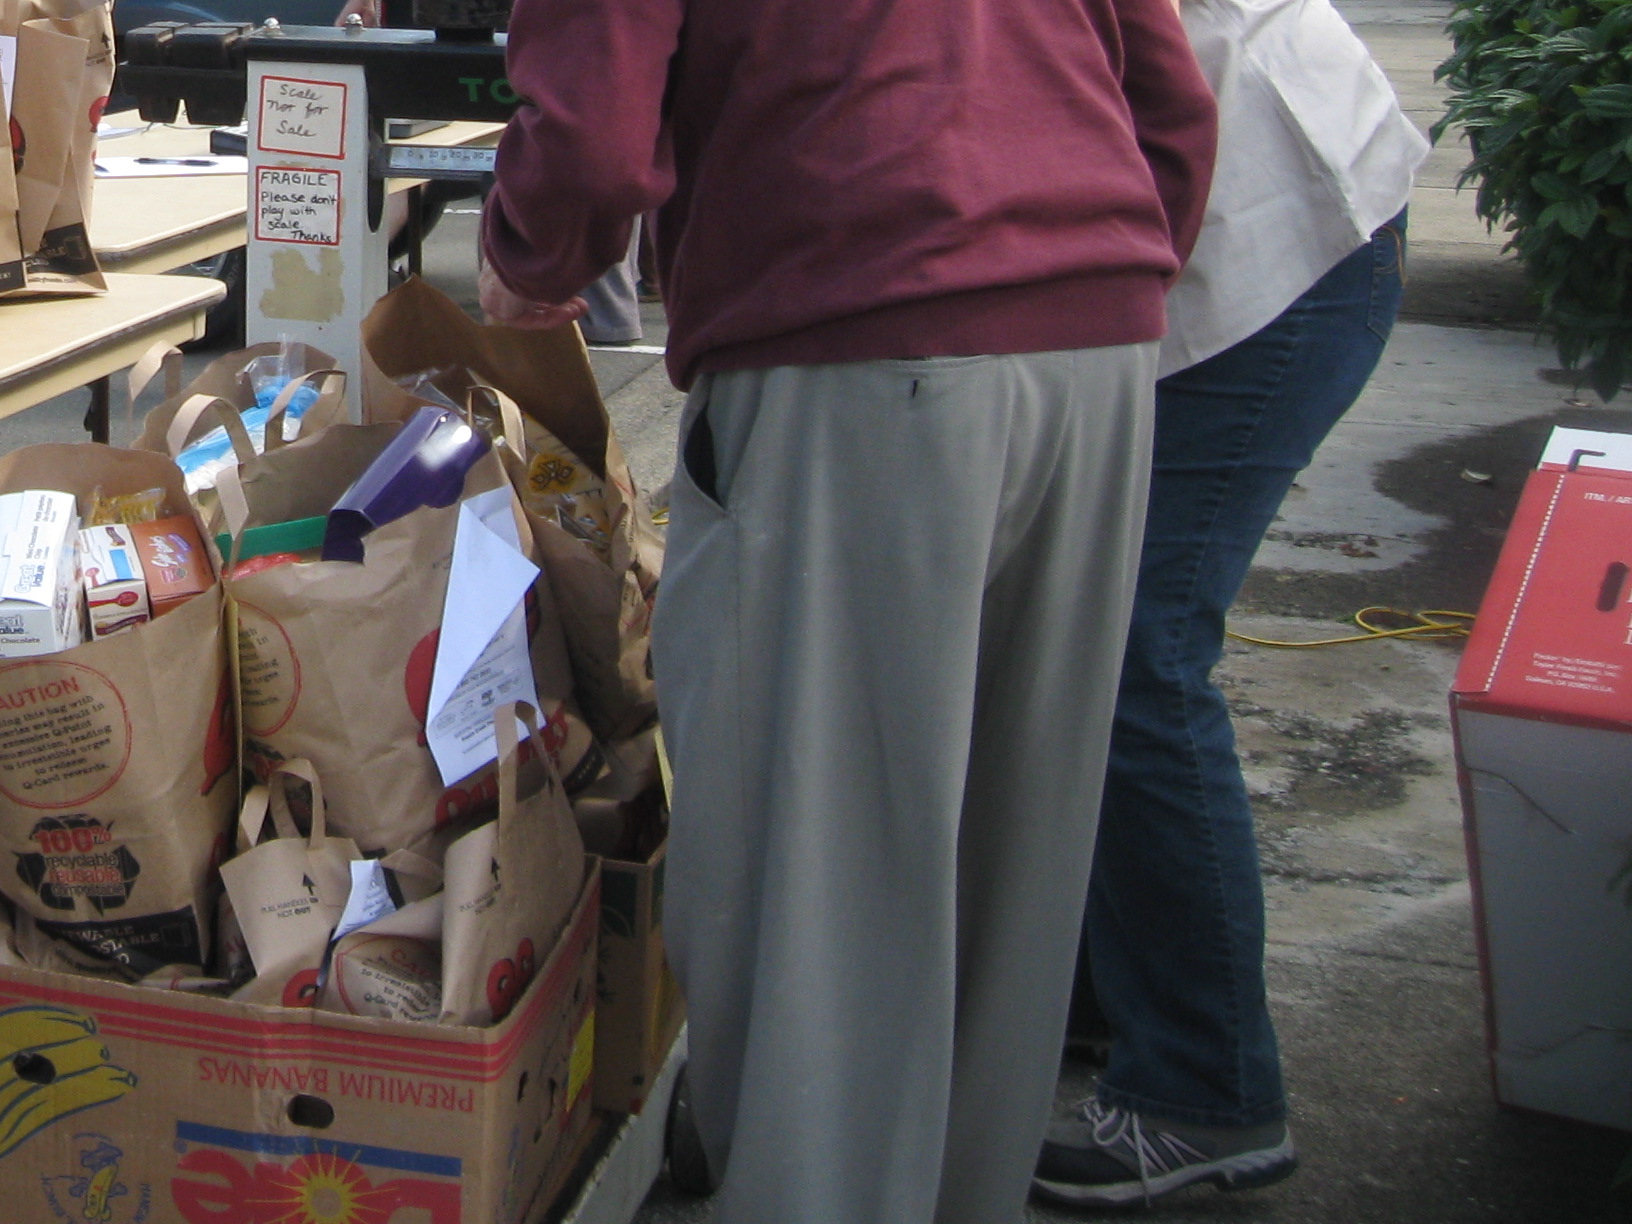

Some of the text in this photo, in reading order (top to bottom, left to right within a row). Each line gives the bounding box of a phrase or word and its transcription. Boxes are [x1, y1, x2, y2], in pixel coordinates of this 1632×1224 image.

[279, 83, 323, 101] Scale
[304, 102, 329, 119] for
[276, 119, 317, 137] Sale
[260, 171, 328, 187] FRAGILE
[261, 191, 337, 206] Please don't
[261, 205, 317, 222] play with
[290, 229, 333, 244] Thanks
[23, 710, 46, 721] this
[46, 704, 68, 716] bag
[68, 695, 94, 708] with
[57, 709, 91, 724] result
[69, 724, 112, 744] leading
[22, 775, 61, 790] Q-Card
[35, 826, 112, 853] 100%
[45, 852, 118, 869] recyclable
[49, 866, 121, 884] reusable
[277, 910, 294, 918] NOT
[198, 1056, 475, 1113] PREMIUM BANANAS
